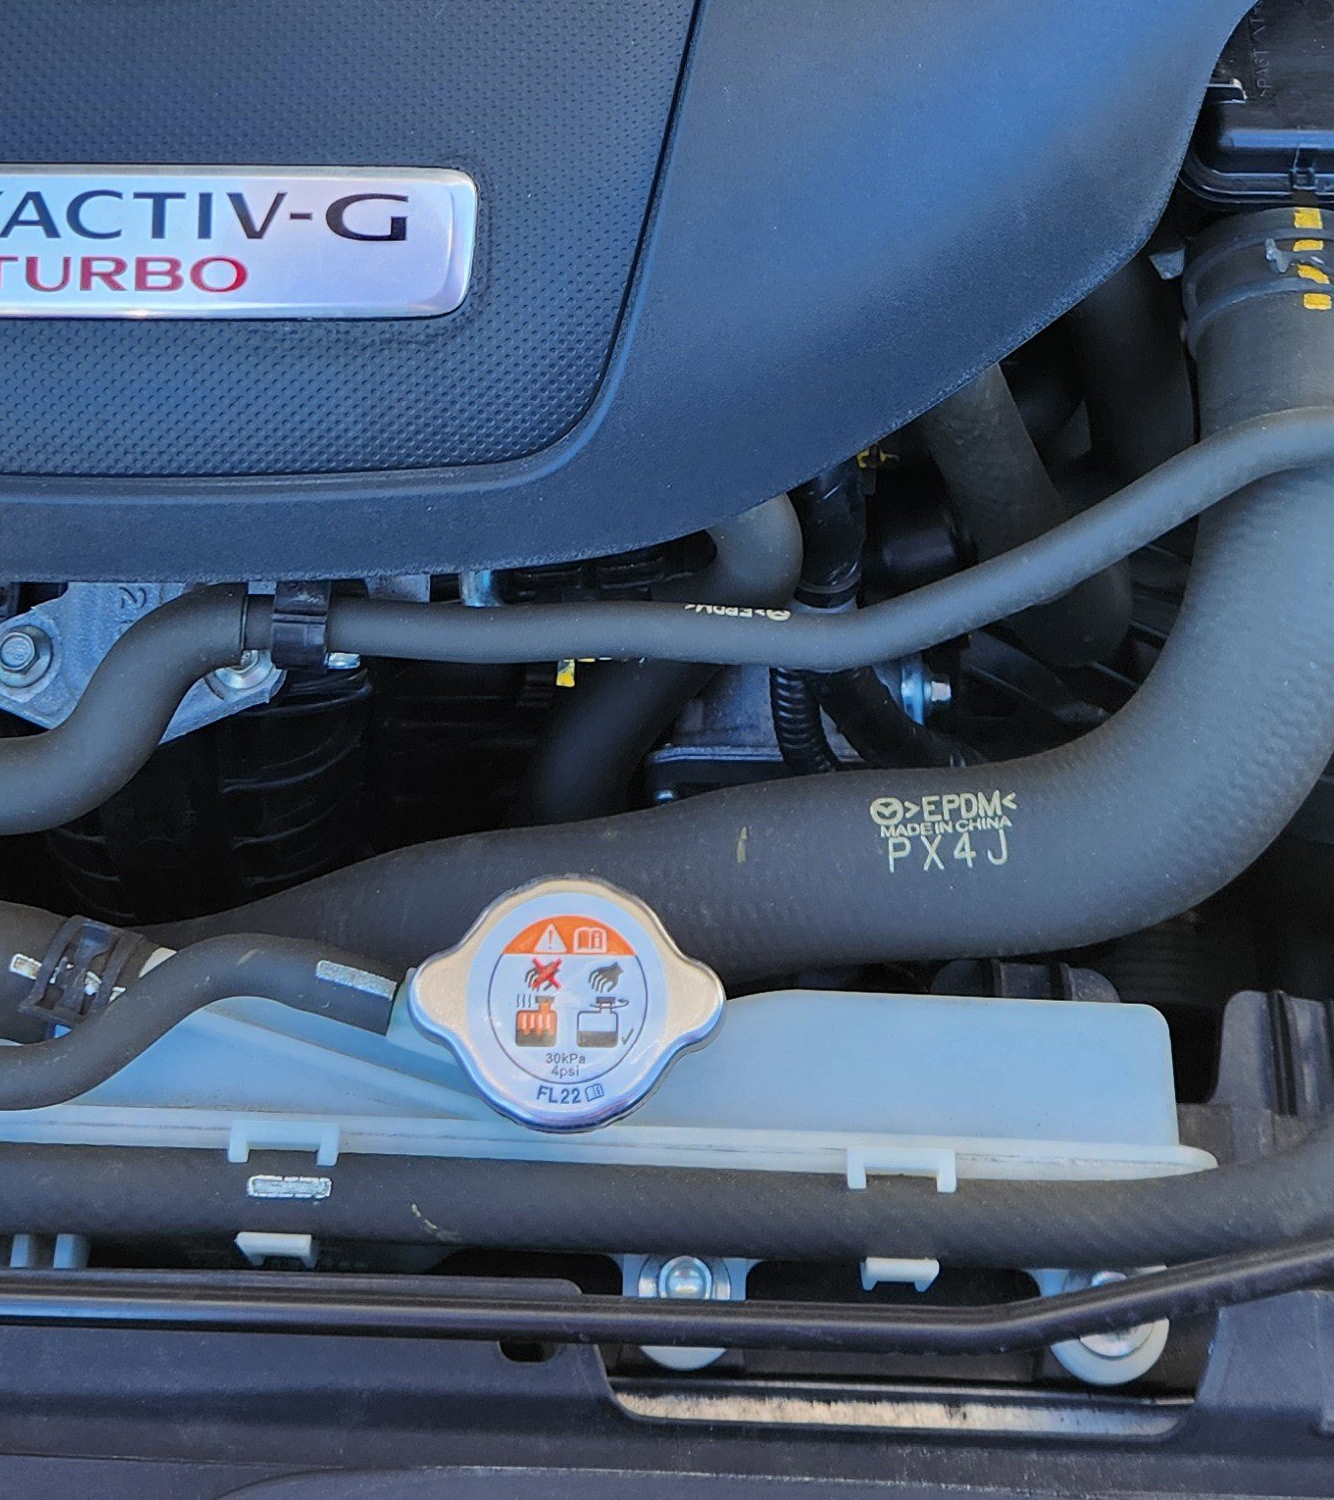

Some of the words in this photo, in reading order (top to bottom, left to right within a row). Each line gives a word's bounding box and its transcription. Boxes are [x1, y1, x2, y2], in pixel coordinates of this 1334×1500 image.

[879, 822, 934, 838] MADE
[934, 820, 954, 835] IN
[955, 815, 1013, 833] CHINA
[545, 1052, 586, 1065] 30kPa
[550, 1064, 580, 1079] 4psi
[536, 1084, 582, 1105] FL22
